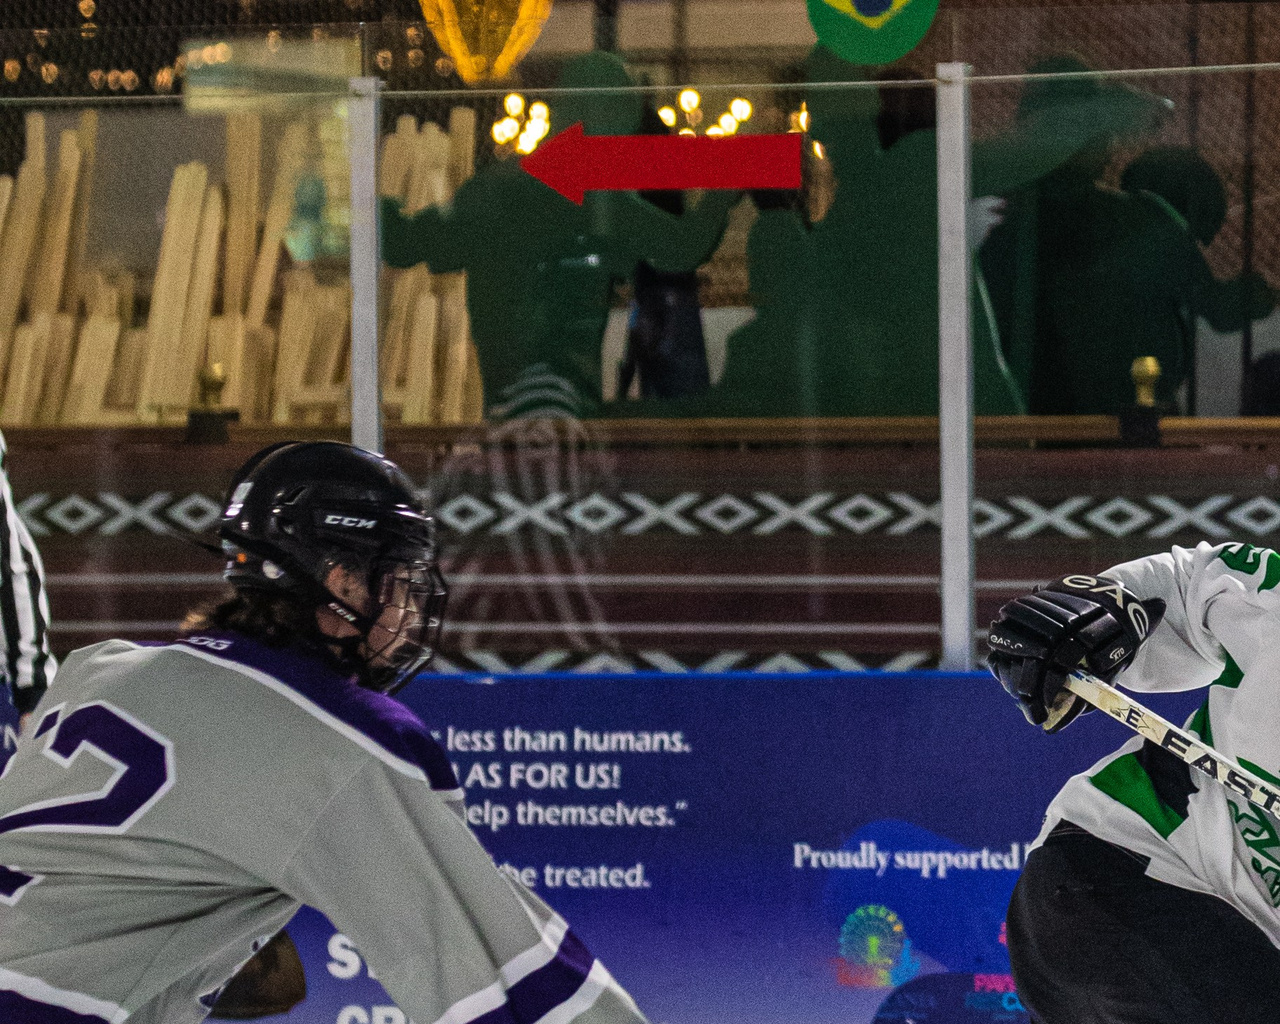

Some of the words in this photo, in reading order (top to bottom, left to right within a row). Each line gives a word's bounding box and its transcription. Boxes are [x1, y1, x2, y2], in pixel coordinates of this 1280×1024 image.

[324, 514, 378, 529] CCM
[447, 726, 496, 751] less
[503, 726, 567, 751] than
[573, 727, 691, 752] humans.
[465, 763, 502, 787] AS
[509, 763, 568, 788] FOR
[575, 763, 621, 788] US!
[465, 800, 510, 832] elp
[793, 841, 890, 877] Proudly
[895, 842, 1020, 879] supported
[544, 862, 651, 888] treated.
